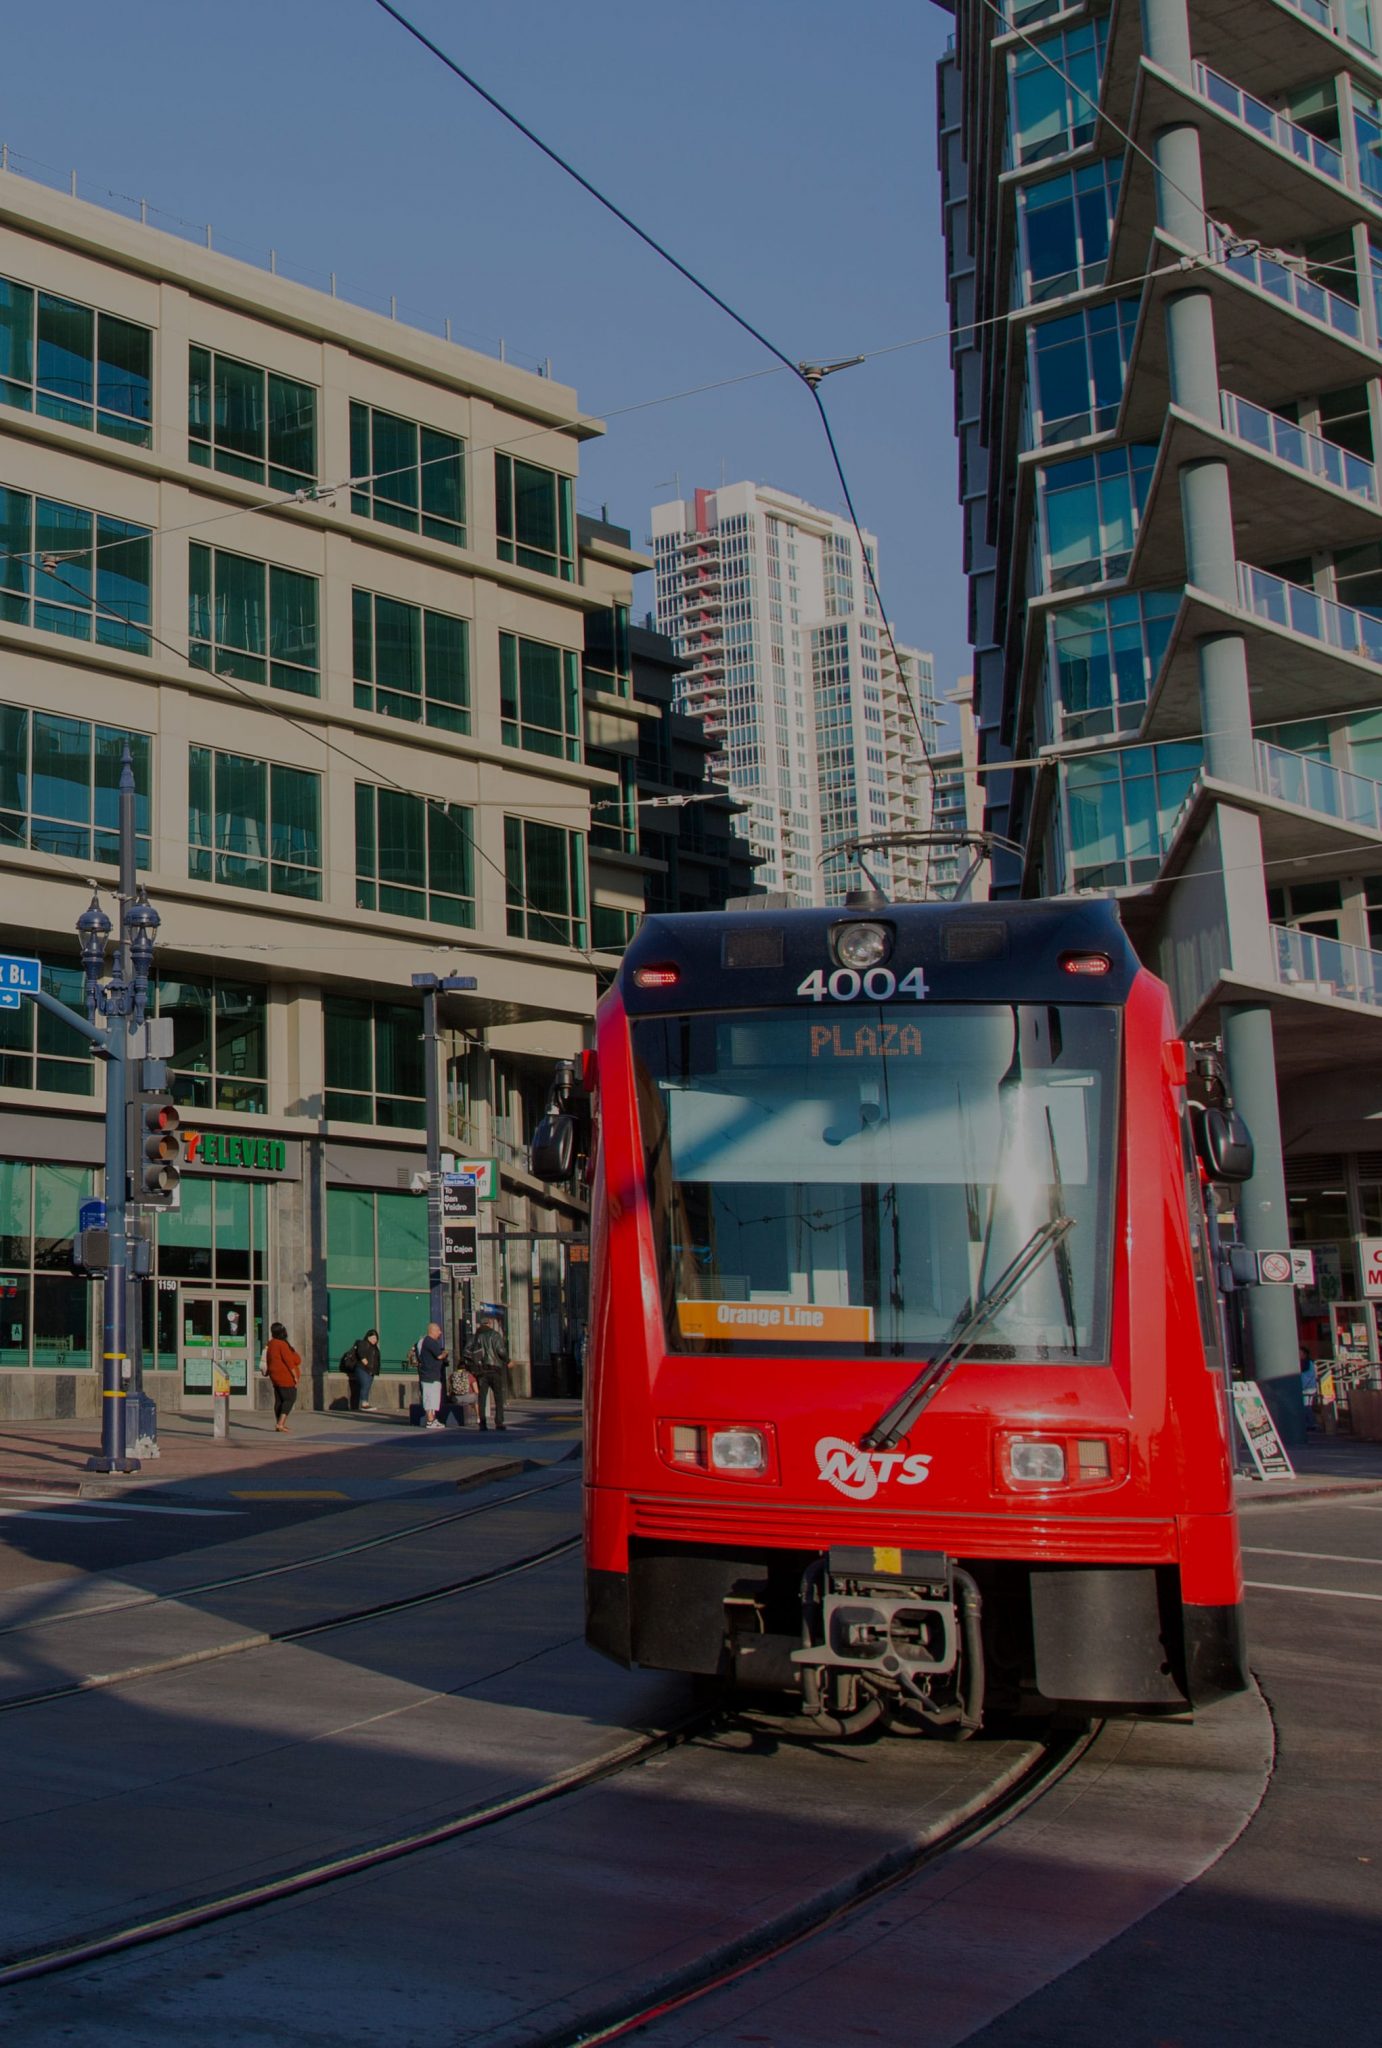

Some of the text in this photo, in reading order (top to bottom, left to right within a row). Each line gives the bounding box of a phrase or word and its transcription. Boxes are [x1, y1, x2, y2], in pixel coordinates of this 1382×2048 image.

[796, 966, 931, 1002] 4004
[810, 1023, 922, 1057] PLAZA
[444, 1195, 458, 1203] San
[444, 1203, 467, 1211] Ysidro
[445, 1245, 473, 1254] El Cajon
[158, 1280, 177, 1291] 1150
[717, 1304, 825, 1327] Orange Line
[817, 1450, 934, 1486] MTS
